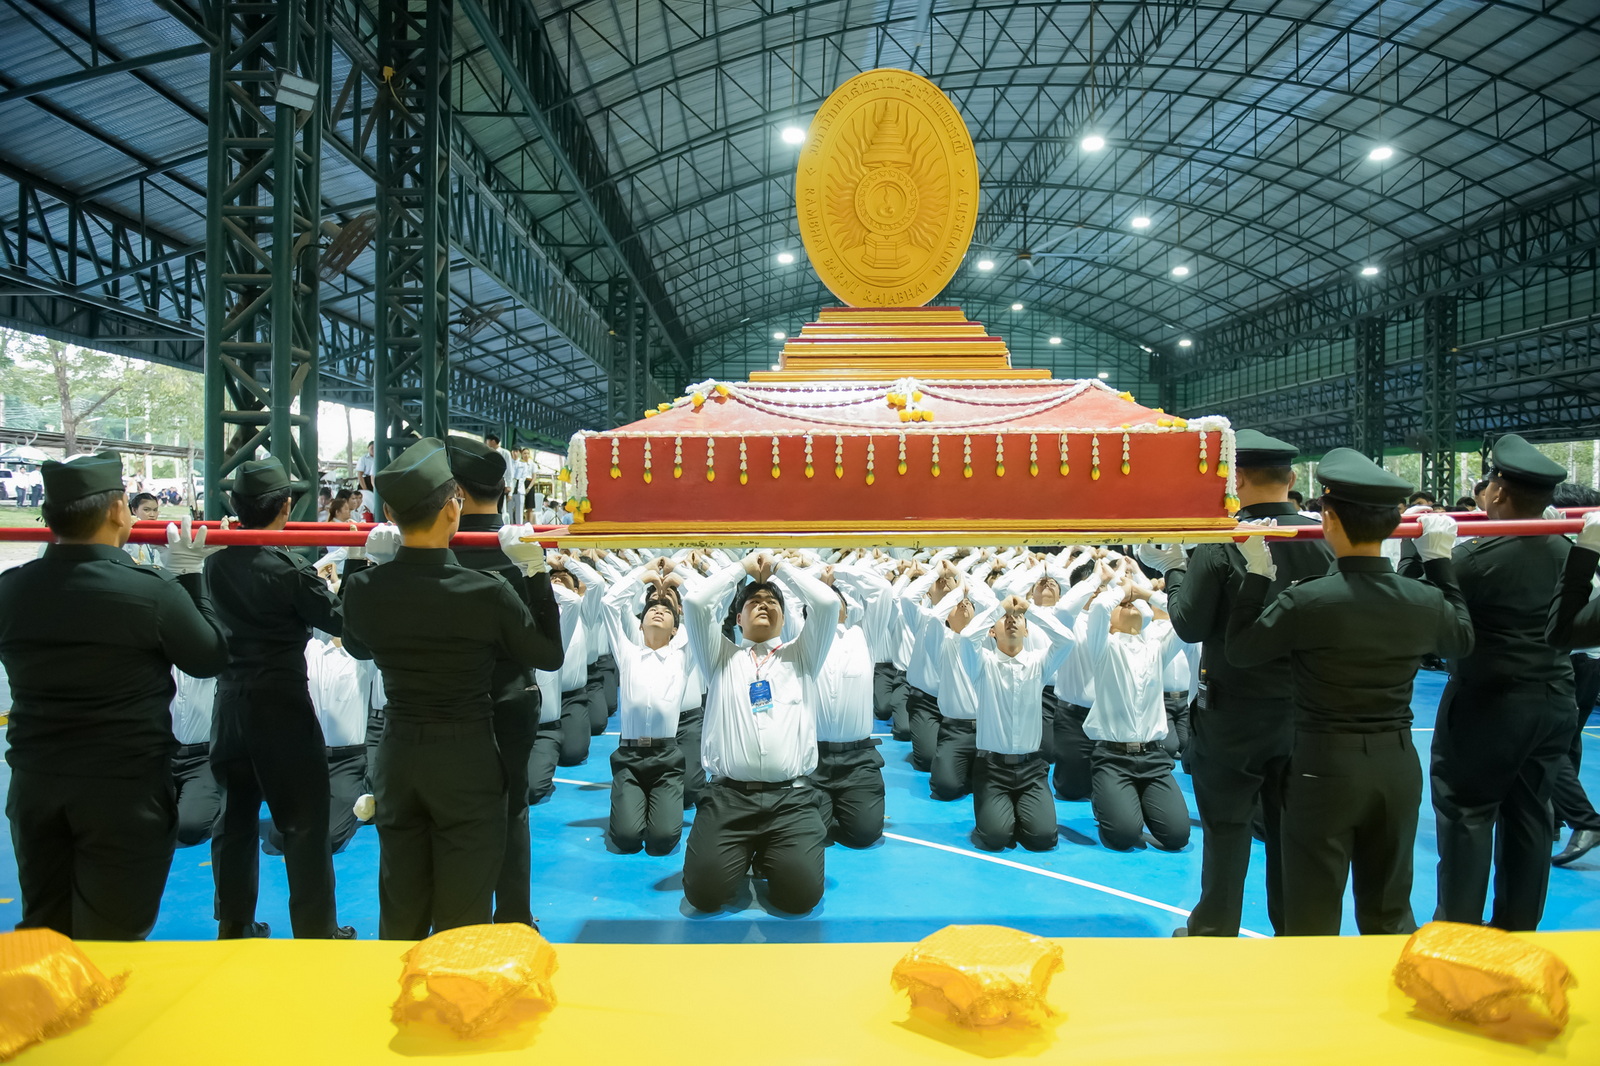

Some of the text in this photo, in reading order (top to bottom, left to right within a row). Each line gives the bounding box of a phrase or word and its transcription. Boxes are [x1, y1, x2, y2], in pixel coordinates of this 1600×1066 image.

[804, 188, 970, 307] RAMBHAI BARNI RAJABHAT UNIVERSITY
